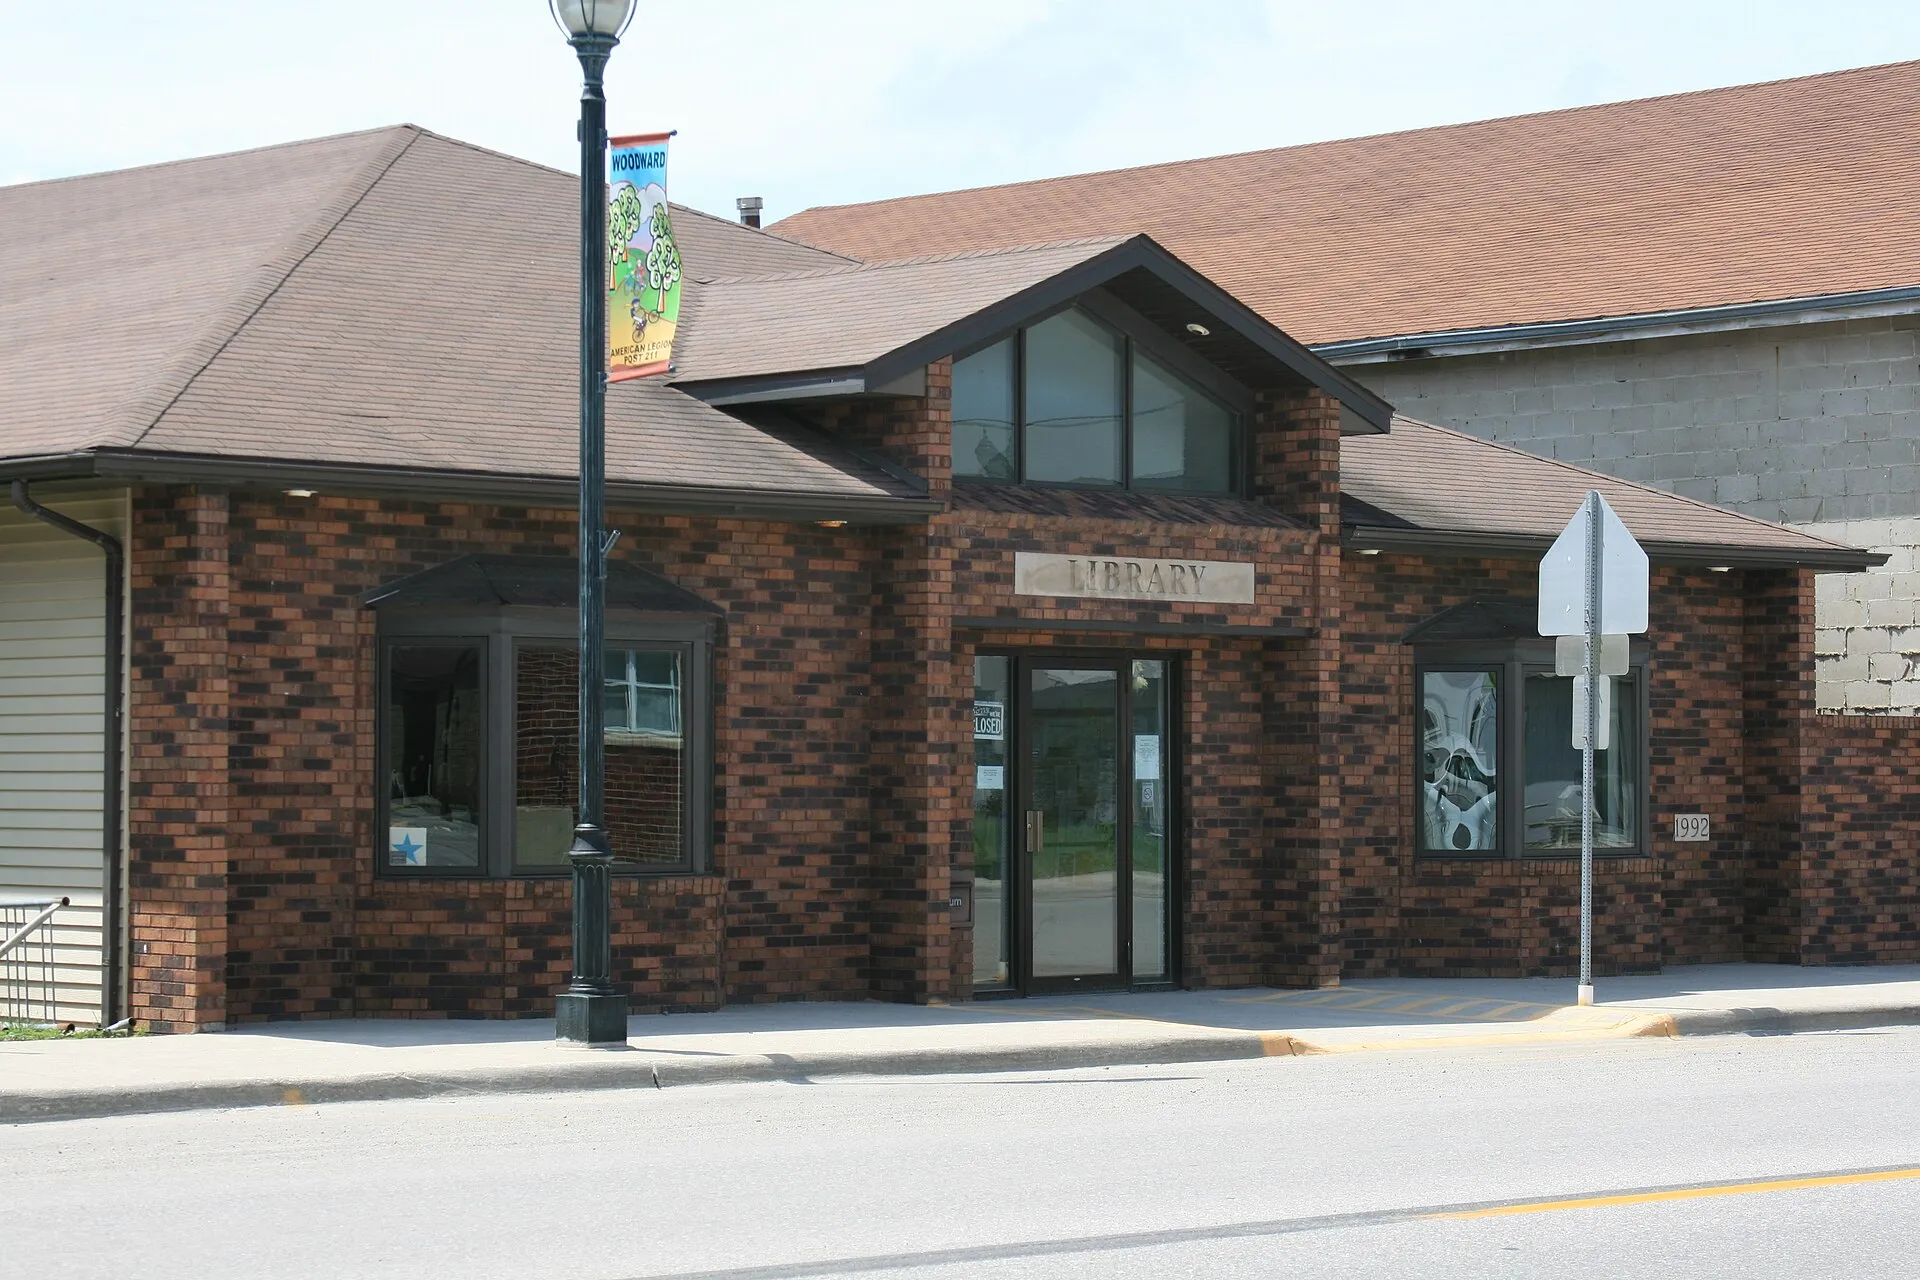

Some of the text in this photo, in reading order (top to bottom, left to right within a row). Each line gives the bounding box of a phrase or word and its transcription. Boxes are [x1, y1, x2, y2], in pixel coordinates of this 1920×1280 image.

[612, 152, 665, 172] WOODWARD
[611, 340, 673, 357] AMERICAN LEGION
[624, 351, 658, 366] POST 211
[1068, 560, 1207, 595] LIBRARY
[973, 717, 1001, 734] LOSED
[1676, 817, 1709, 838] 1992
